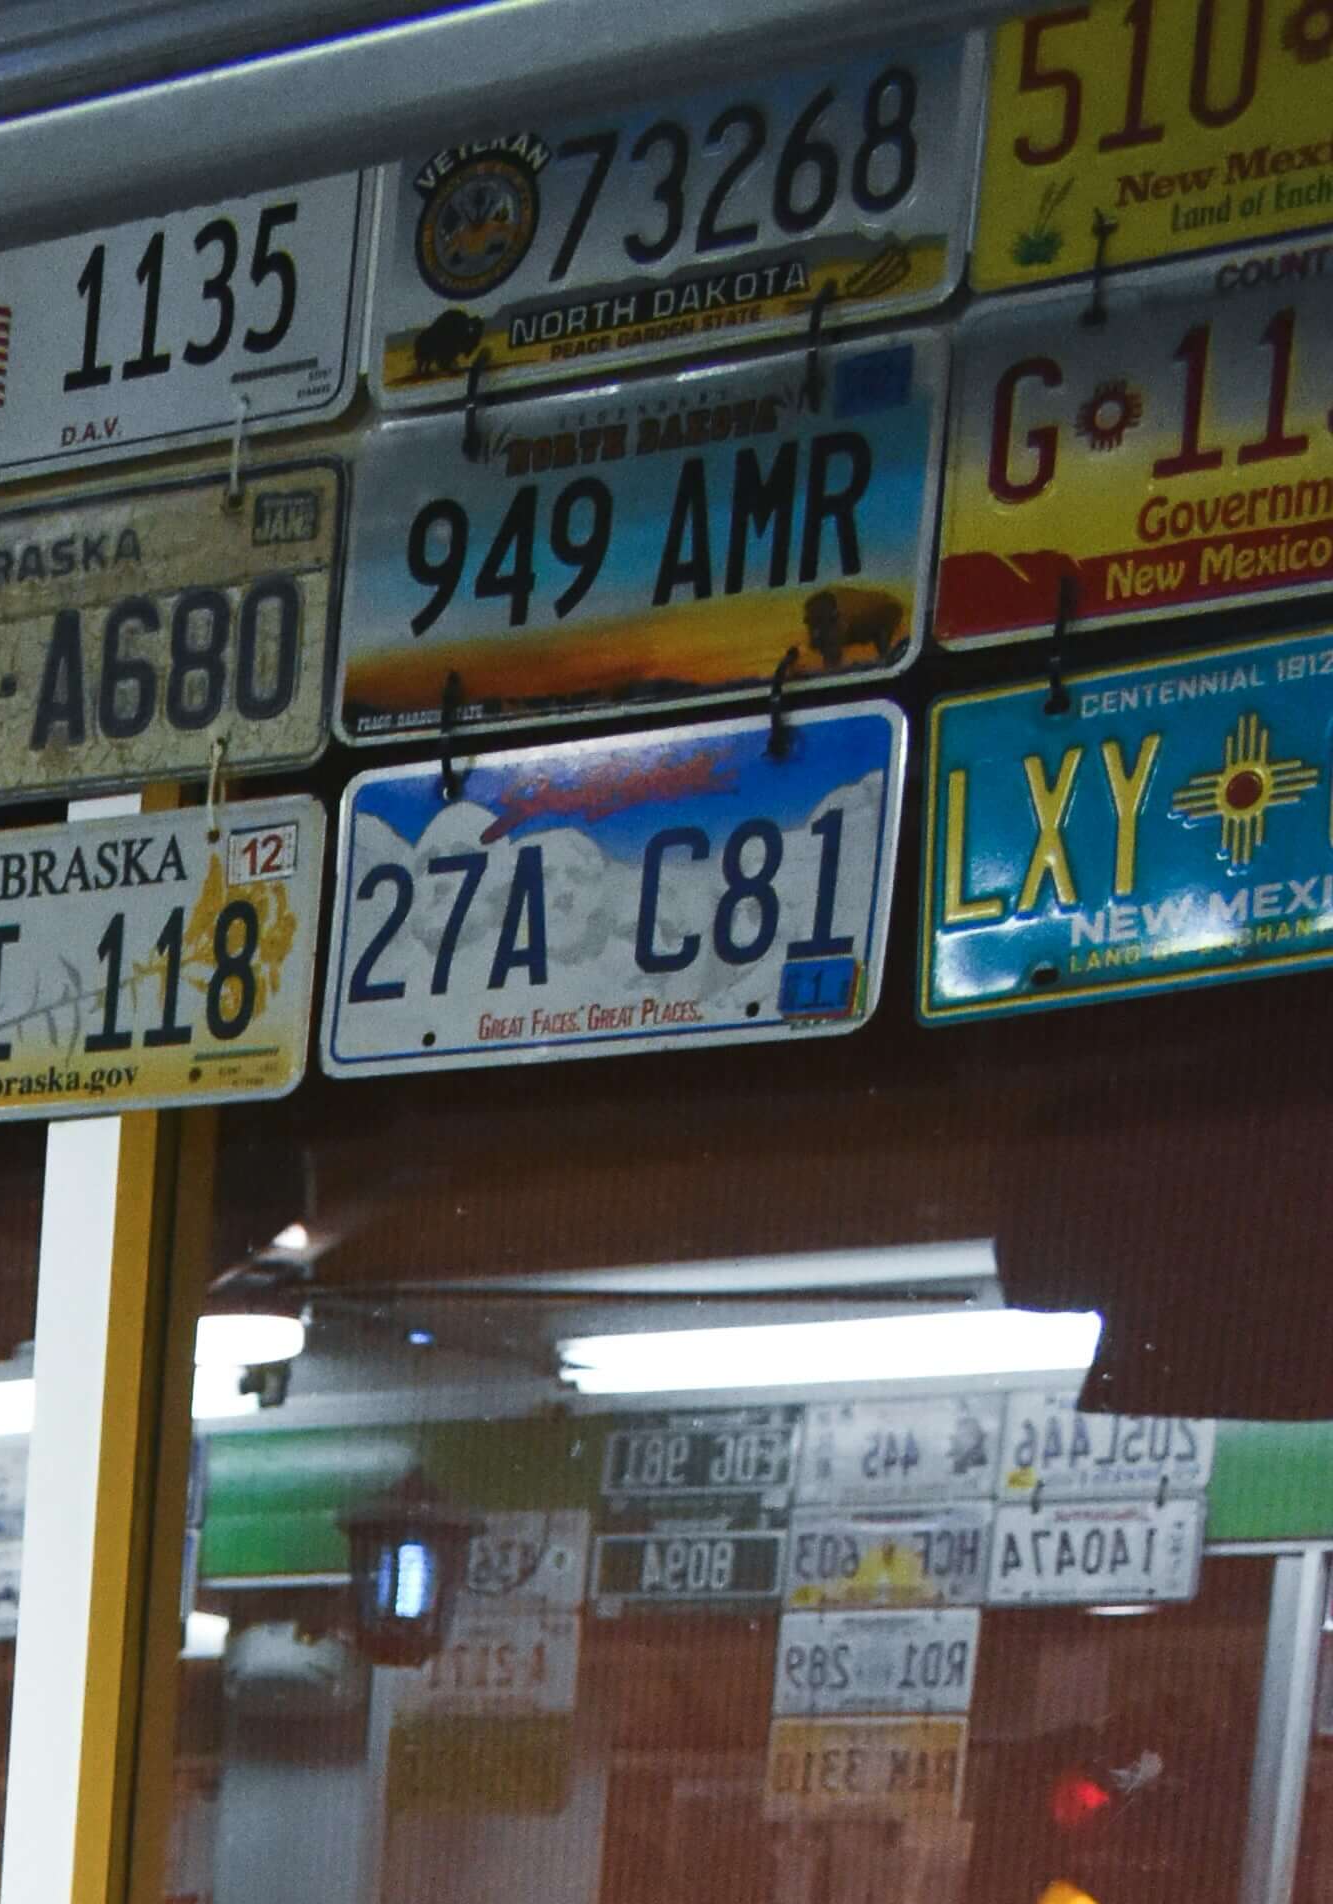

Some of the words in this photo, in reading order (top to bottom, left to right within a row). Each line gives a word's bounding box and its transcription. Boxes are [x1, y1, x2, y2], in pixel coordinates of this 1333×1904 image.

[548, 65, 919, 283] 73268
[1116, 166, 1216, 209] New
[1171, 198, 1230, 233] Land
[1239, 189, 1266, 218] of
[63, 201, 298, 394] 1135
[508, 297, 638, 348] NORTH
[652, 260, 810, 319] DAKOTA
[549, 331, 611, 361] PEACE
[616, 316, 694, 351] GARDEN
[700, 304, 764, 335] STATE
[60, 417, 123, 448] D.A.V.
[505, 422, 629, 478] NORTH
[635, 400, 781, 458] DAKOTA
[406, 475, 615, 638] 949
[652, 430, 874, 608] AMR
[1106, 558, 1186, 602] New
[1198, 532, 1333, 586] Mexico
[1080, 669, 1265, 720] CENTENNIAL
[241, 837, 284, 877] 12
[943, 733, 1162, 925] LXY
[347, 844, 549, 1004] 27A
[633, 806, 855, 976] C81
[1070, 895, 1195, 948] NEW
[84, 899, 259, 1054] 118
[1070, 947, 1143, 974] LAND
